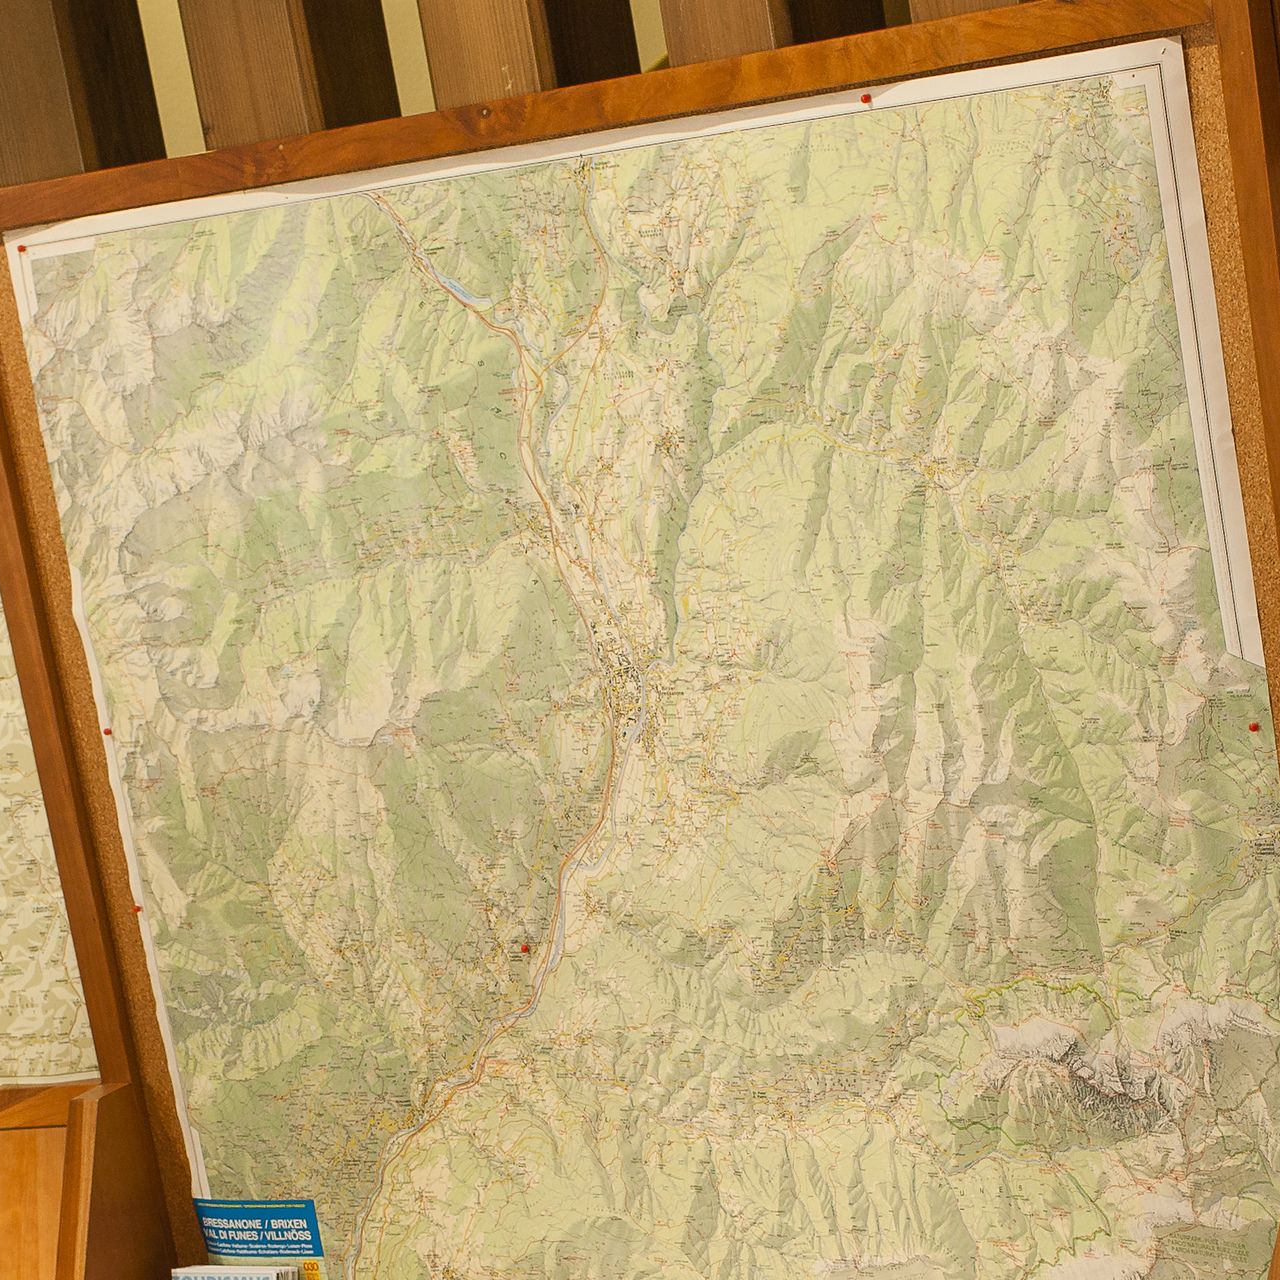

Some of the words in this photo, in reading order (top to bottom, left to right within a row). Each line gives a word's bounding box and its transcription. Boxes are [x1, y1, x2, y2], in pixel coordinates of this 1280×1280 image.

[203, 1217, 262, 1229] BRESSANONE
[270, 1218, 307, 1230] BRIXEN
[219, 1229, 227, 1240] DI
[229, 1229, 259, 1241] FUNES
[265, 1228, 312, 1242] VILLNÖSS
